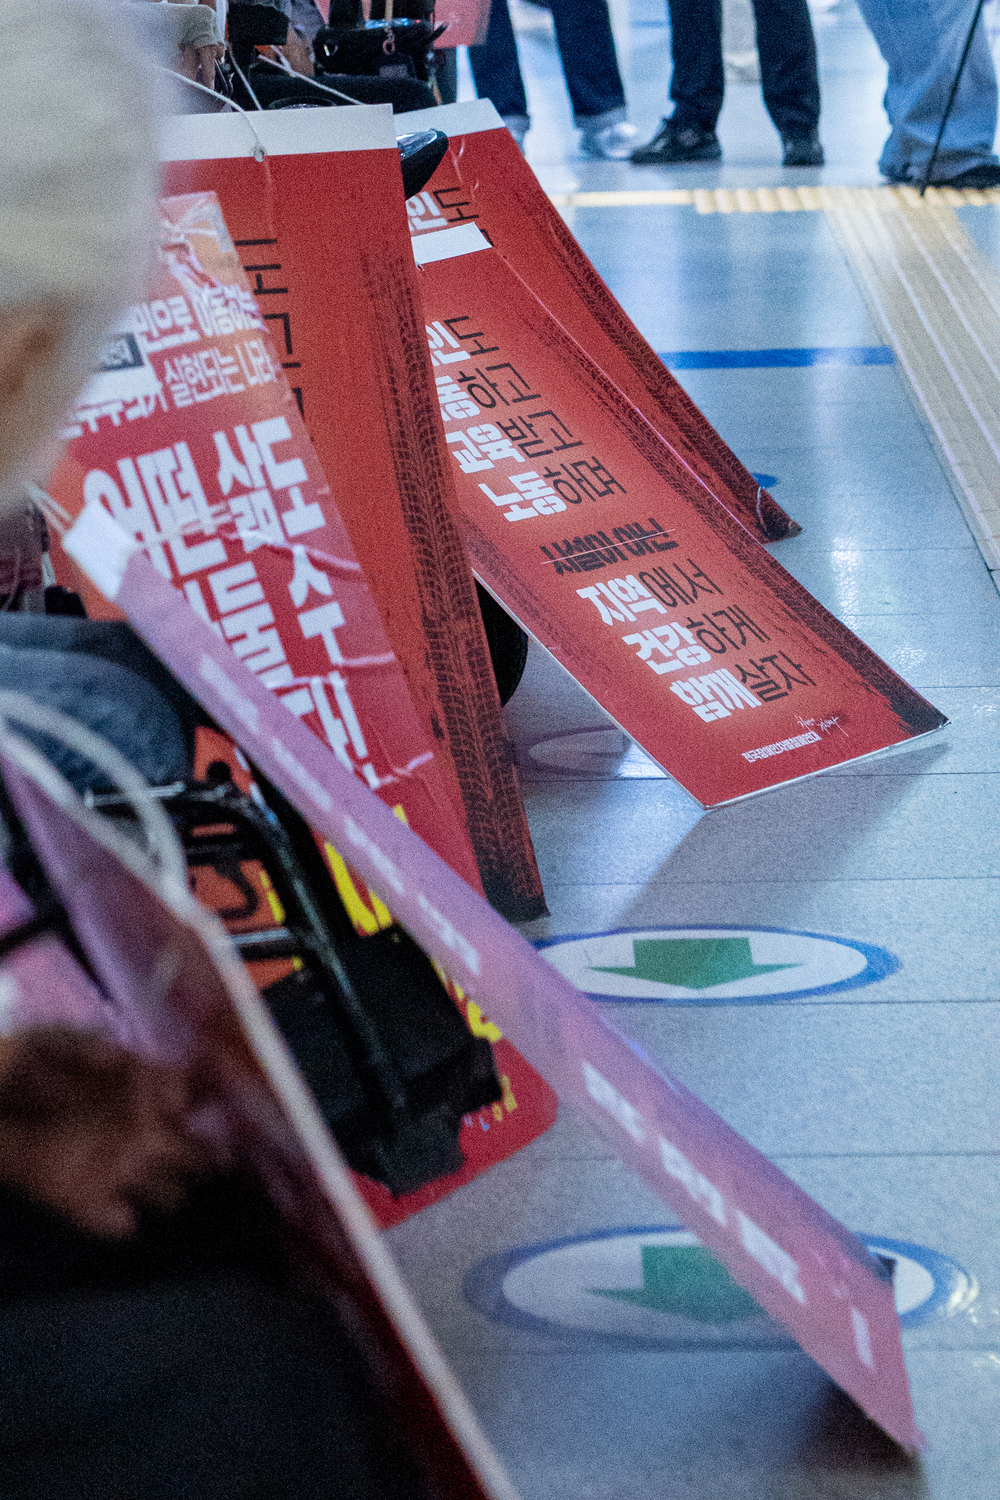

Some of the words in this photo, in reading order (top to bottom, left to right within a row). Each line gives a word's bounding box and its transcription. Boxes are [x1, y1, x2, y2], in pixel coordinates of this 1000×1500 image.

[435, 362, 541, 422] 동하고
[445, 410, 584, 474] 교육받고
[478, 456, 627, 522] 노동하며
[288, 543, 345, 664] 수
[576, 558, 724, 626] 지역에서
[622, 604, 771, 675] 건강하게
